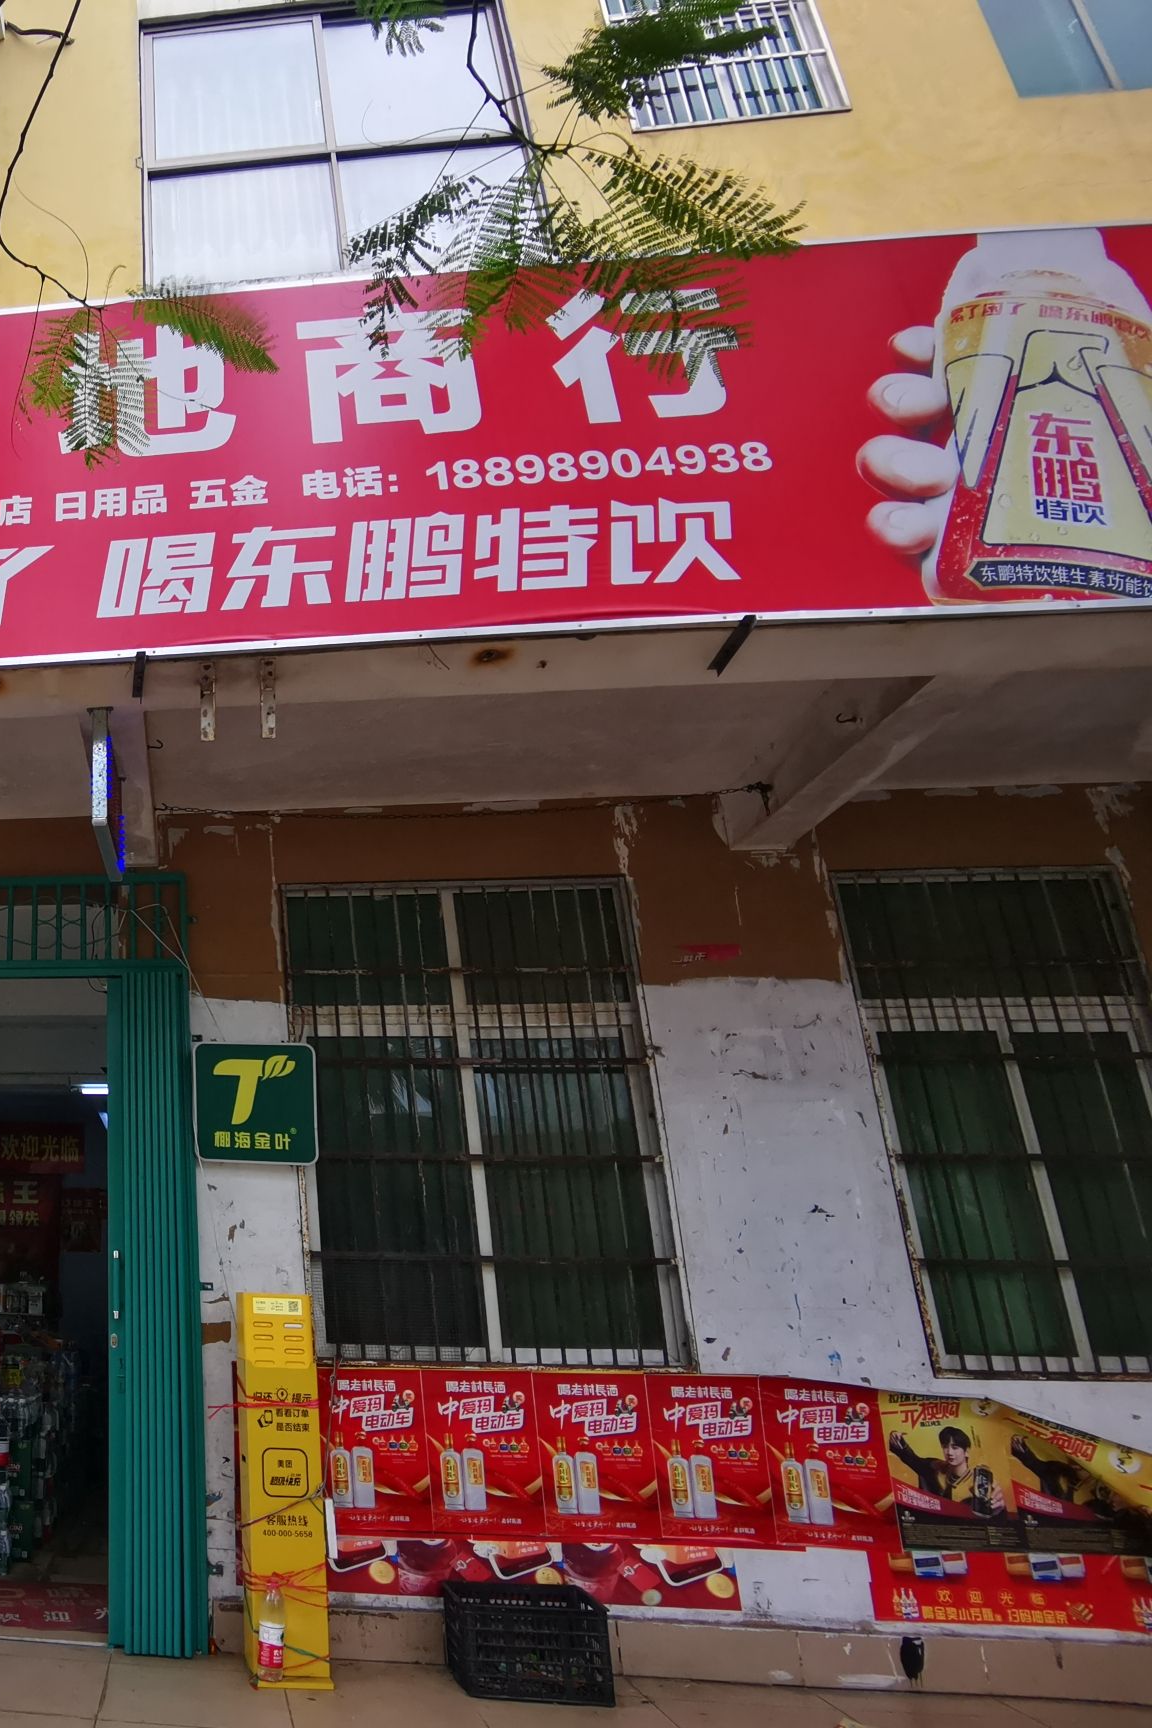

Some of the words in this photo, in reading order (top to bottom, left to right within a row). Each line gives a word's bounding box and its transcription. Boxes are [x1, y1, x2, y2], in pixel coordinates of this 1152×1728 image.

[54, 484, 168, 522] 日用品
[189, 475, 269, 510] 五金
[425, 441, 773, 491] 18898904938
[96, 497, 741, 619] 喝东鹏特饮
[0, 1134, 80, 1163] 欢迎光临
[214, 1131, 291, 1150] 椰海金叶
[276, 1408, 309, 1418] 看看订单
[352, 1397, 383, 1414] 爱玛
[461, 1398, 492, 1415] 爱玛
[574, 1401, 605, 1419] 爱玛
[688, 1404, 719, 1422] 爱玛
[365, 1411, 410, 1429] 电动车
[475, 1412, 521, 1430] 电动车
[588, 1415, 634, 1433] 电动车
[802, 1408, 834, 1425] 爱玛
[276, 1423, 310, 1432] 是否结束
[702, 1418, 749, 1437] 电动车
[817, 1425, 867, 1441] 电动车
[277, 1459, 293, 1469] 美团
[266, 1514, 308, 1527] 客服热线
